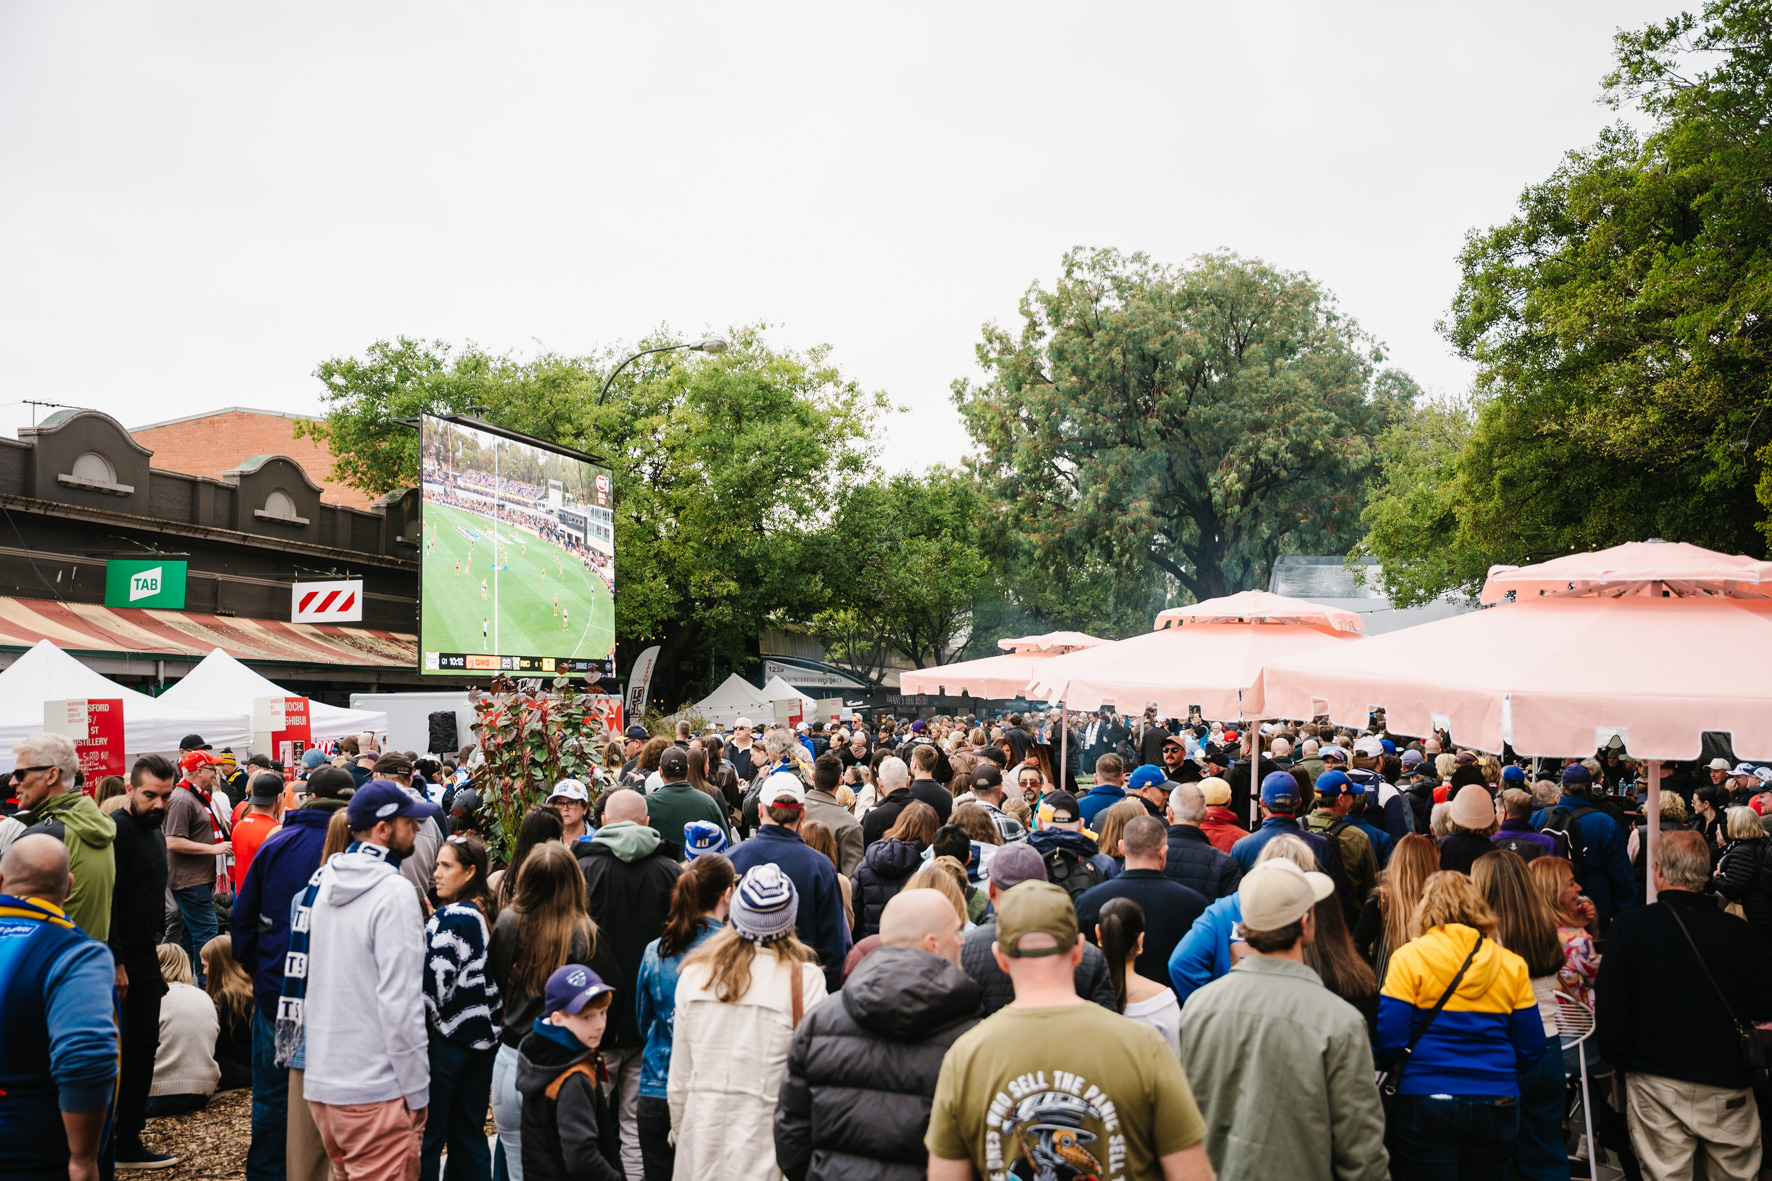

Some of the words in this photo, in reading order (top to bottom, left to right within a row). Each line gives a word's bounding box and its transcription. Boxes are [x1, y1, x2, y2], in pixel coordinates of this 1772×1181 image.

[134, 578, 158, 591] TAB
[475, 659, 490, 667] GWS
[87, 704, 109, 712] SFORD
[90, 726, 99, 735] ST
[986, 1092, 1014, 1127] WHO
[1008, 1070, 1049, 1099] SELL
[1053, 1070, 1086, 1095] THE
[1083, 1084, 1120, 1132] PANIC
[1108, 1134, 1127, 1174] SELL
